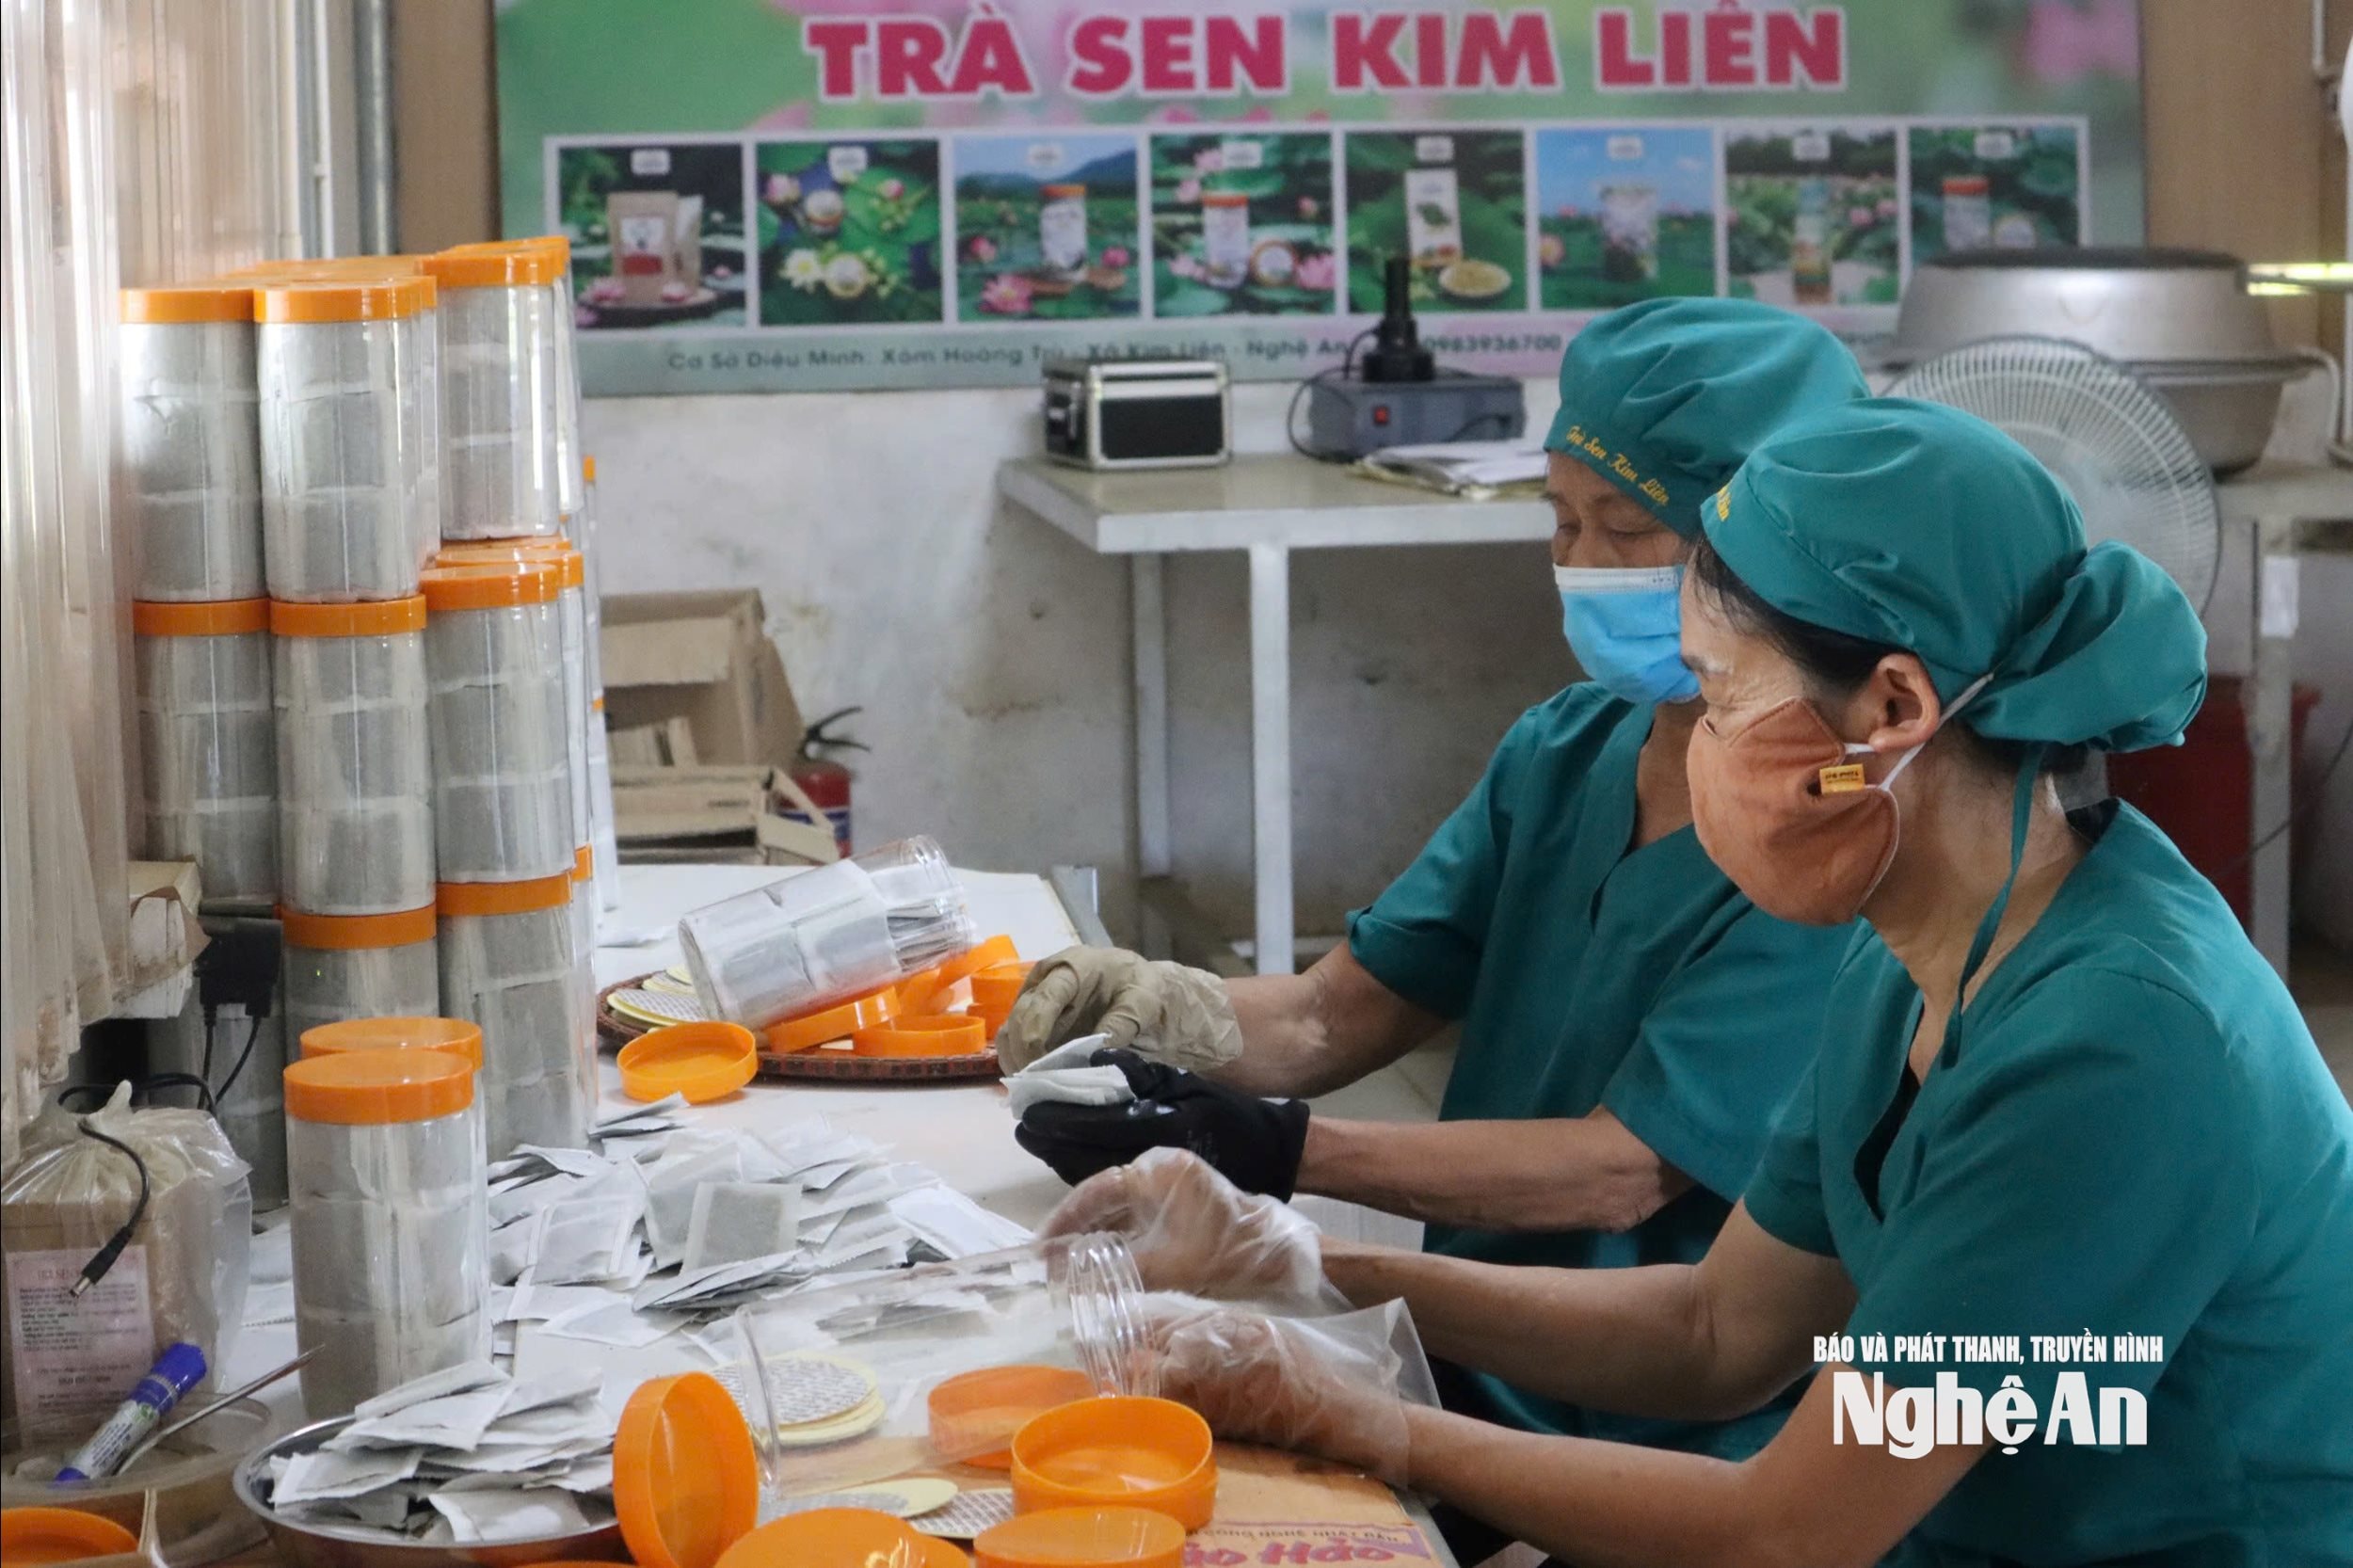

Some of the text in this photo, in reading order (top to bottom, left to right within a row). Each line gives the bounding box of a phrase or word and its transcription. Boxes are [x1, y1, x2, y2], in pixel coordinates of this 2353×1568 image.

[807, 0, 1842, 95] TRÀ SEN KIM LIÊN
[1584, 437, 1607, 459] Sen
[1608, 453, 1639, 482] Kim
[1257, 1536, 1395, 1566] Hảo
